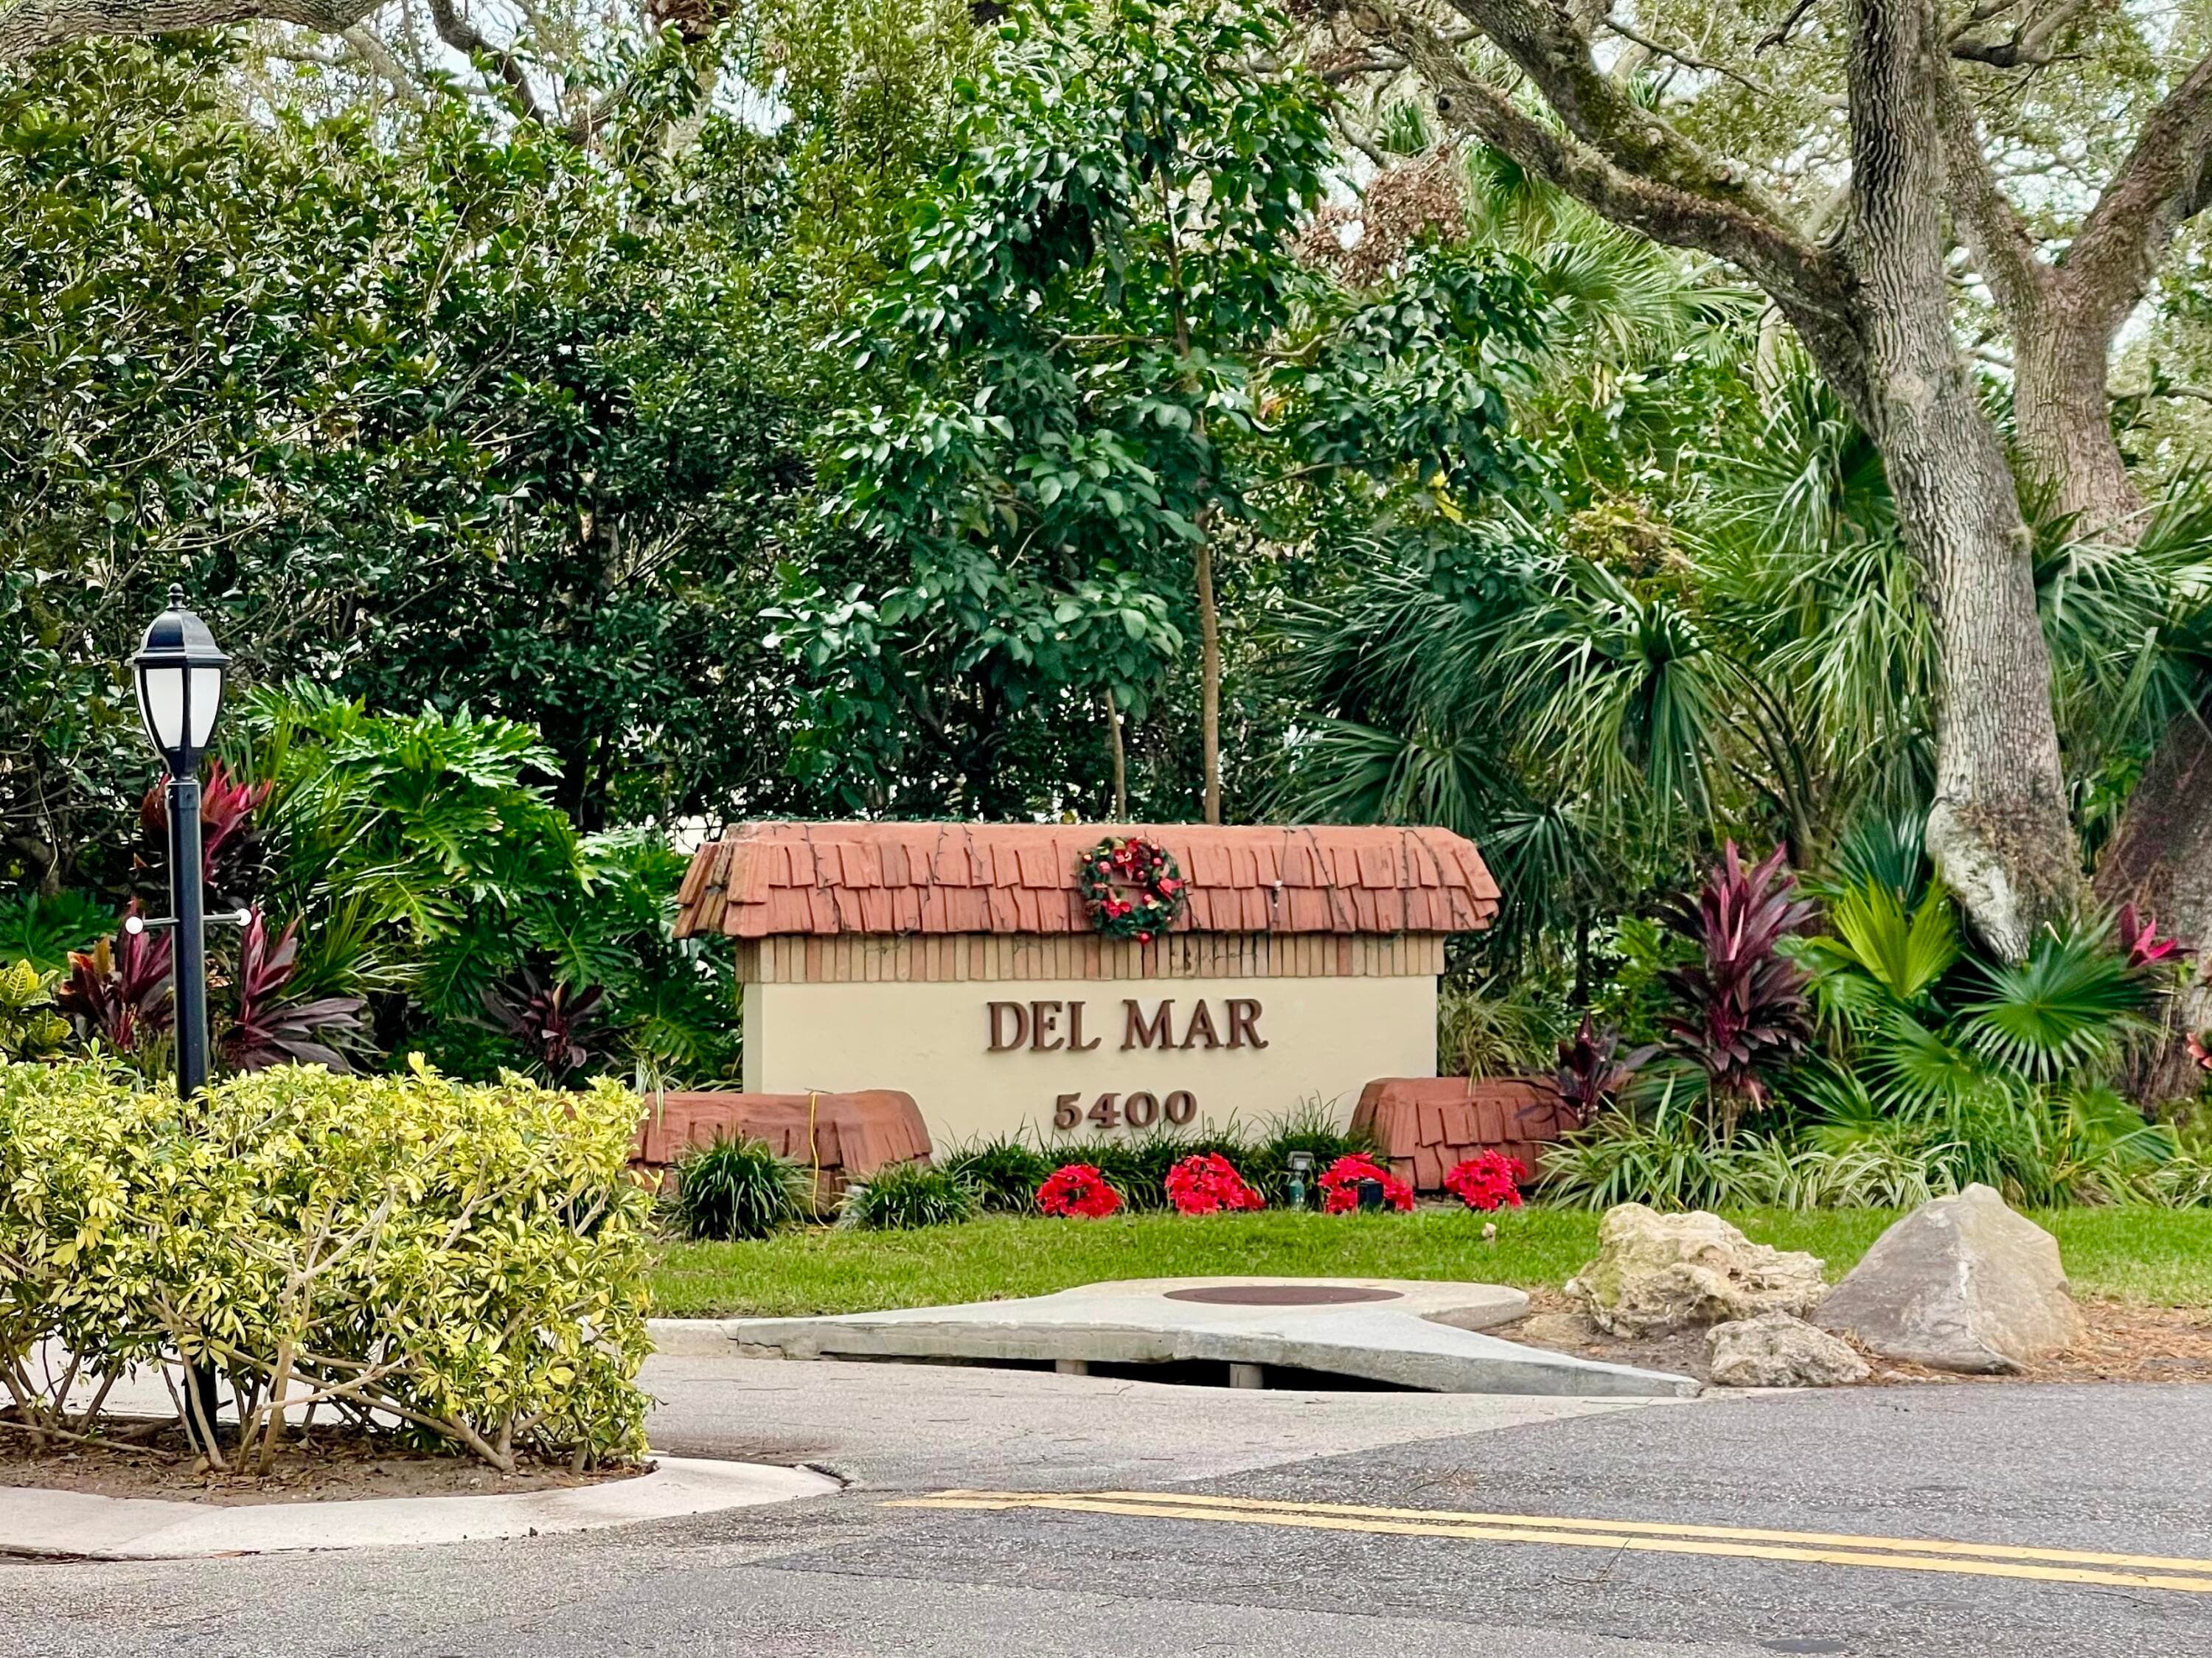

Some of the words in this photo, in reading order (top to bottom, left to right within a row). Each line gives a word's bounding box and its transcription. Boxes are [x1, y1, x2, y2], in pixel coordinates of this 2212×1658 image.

[987, 1000, 1102, 1052] DEL
[1120, 998, 1269, 1051] MAR
[1054, 1090, 1197, 1129] 5400
